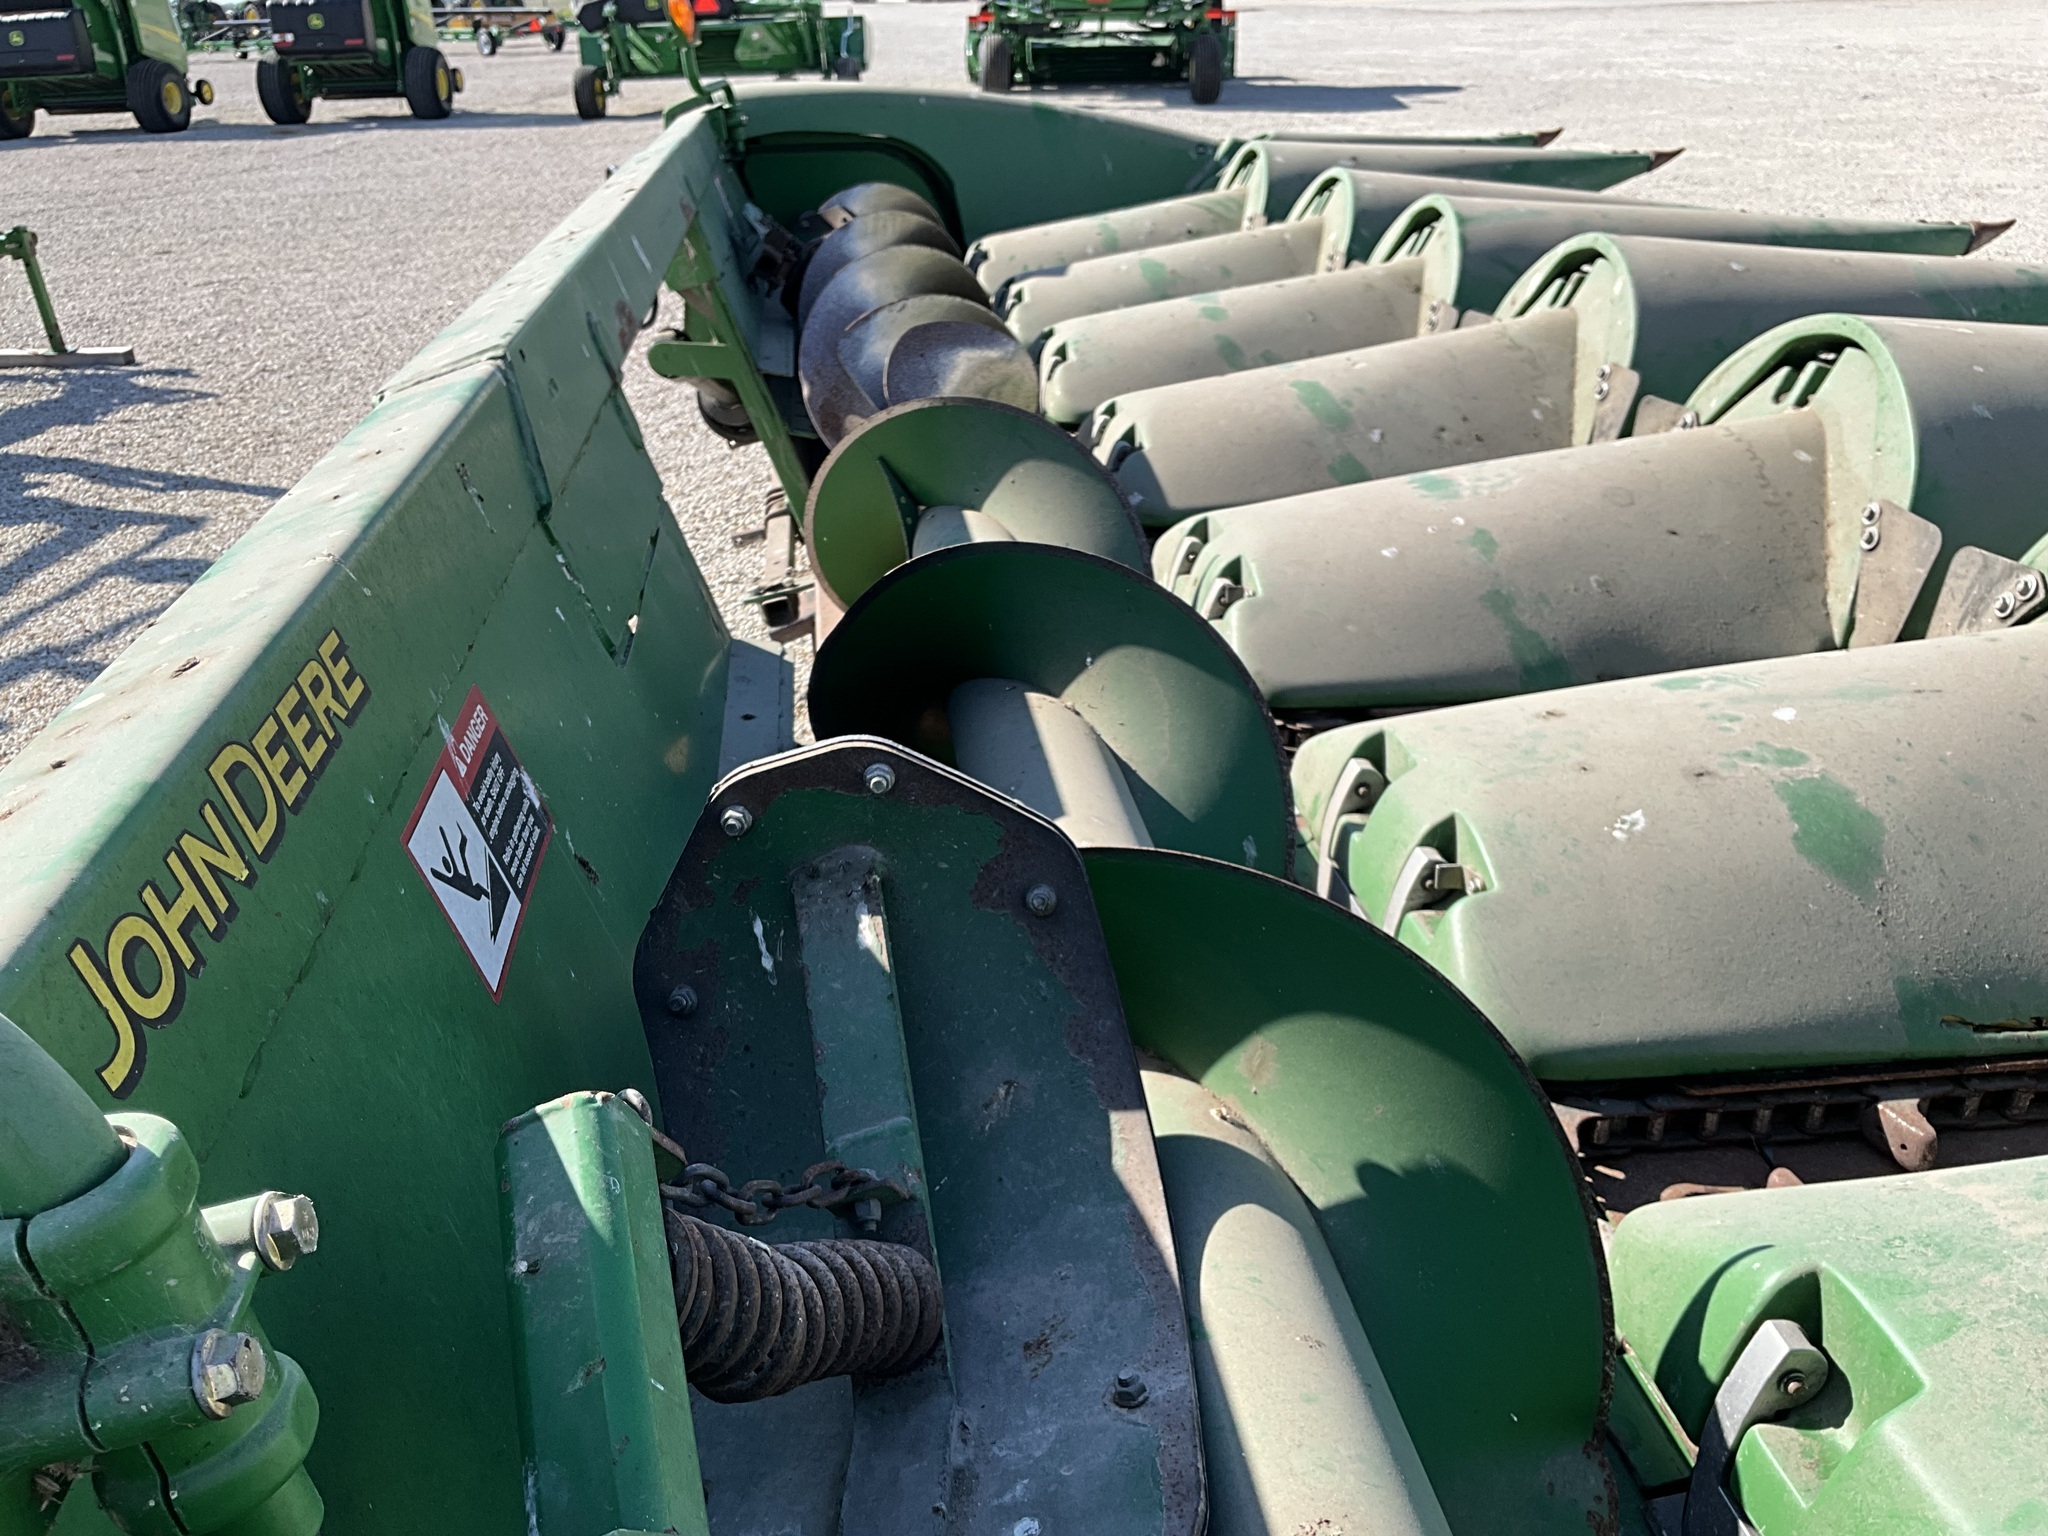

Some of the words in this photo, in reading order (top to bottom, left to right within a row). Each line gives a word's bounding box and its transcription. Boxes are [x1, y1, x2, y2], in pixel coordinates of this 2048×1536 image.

[459, 704, 488, 764] DANGER
[489, 777, 501, 800] SHUT
[496, 765, 505, 783] OFF
[68, 801, 254, 1096] JOHN
[206, 628, 368, 859] DEERE
